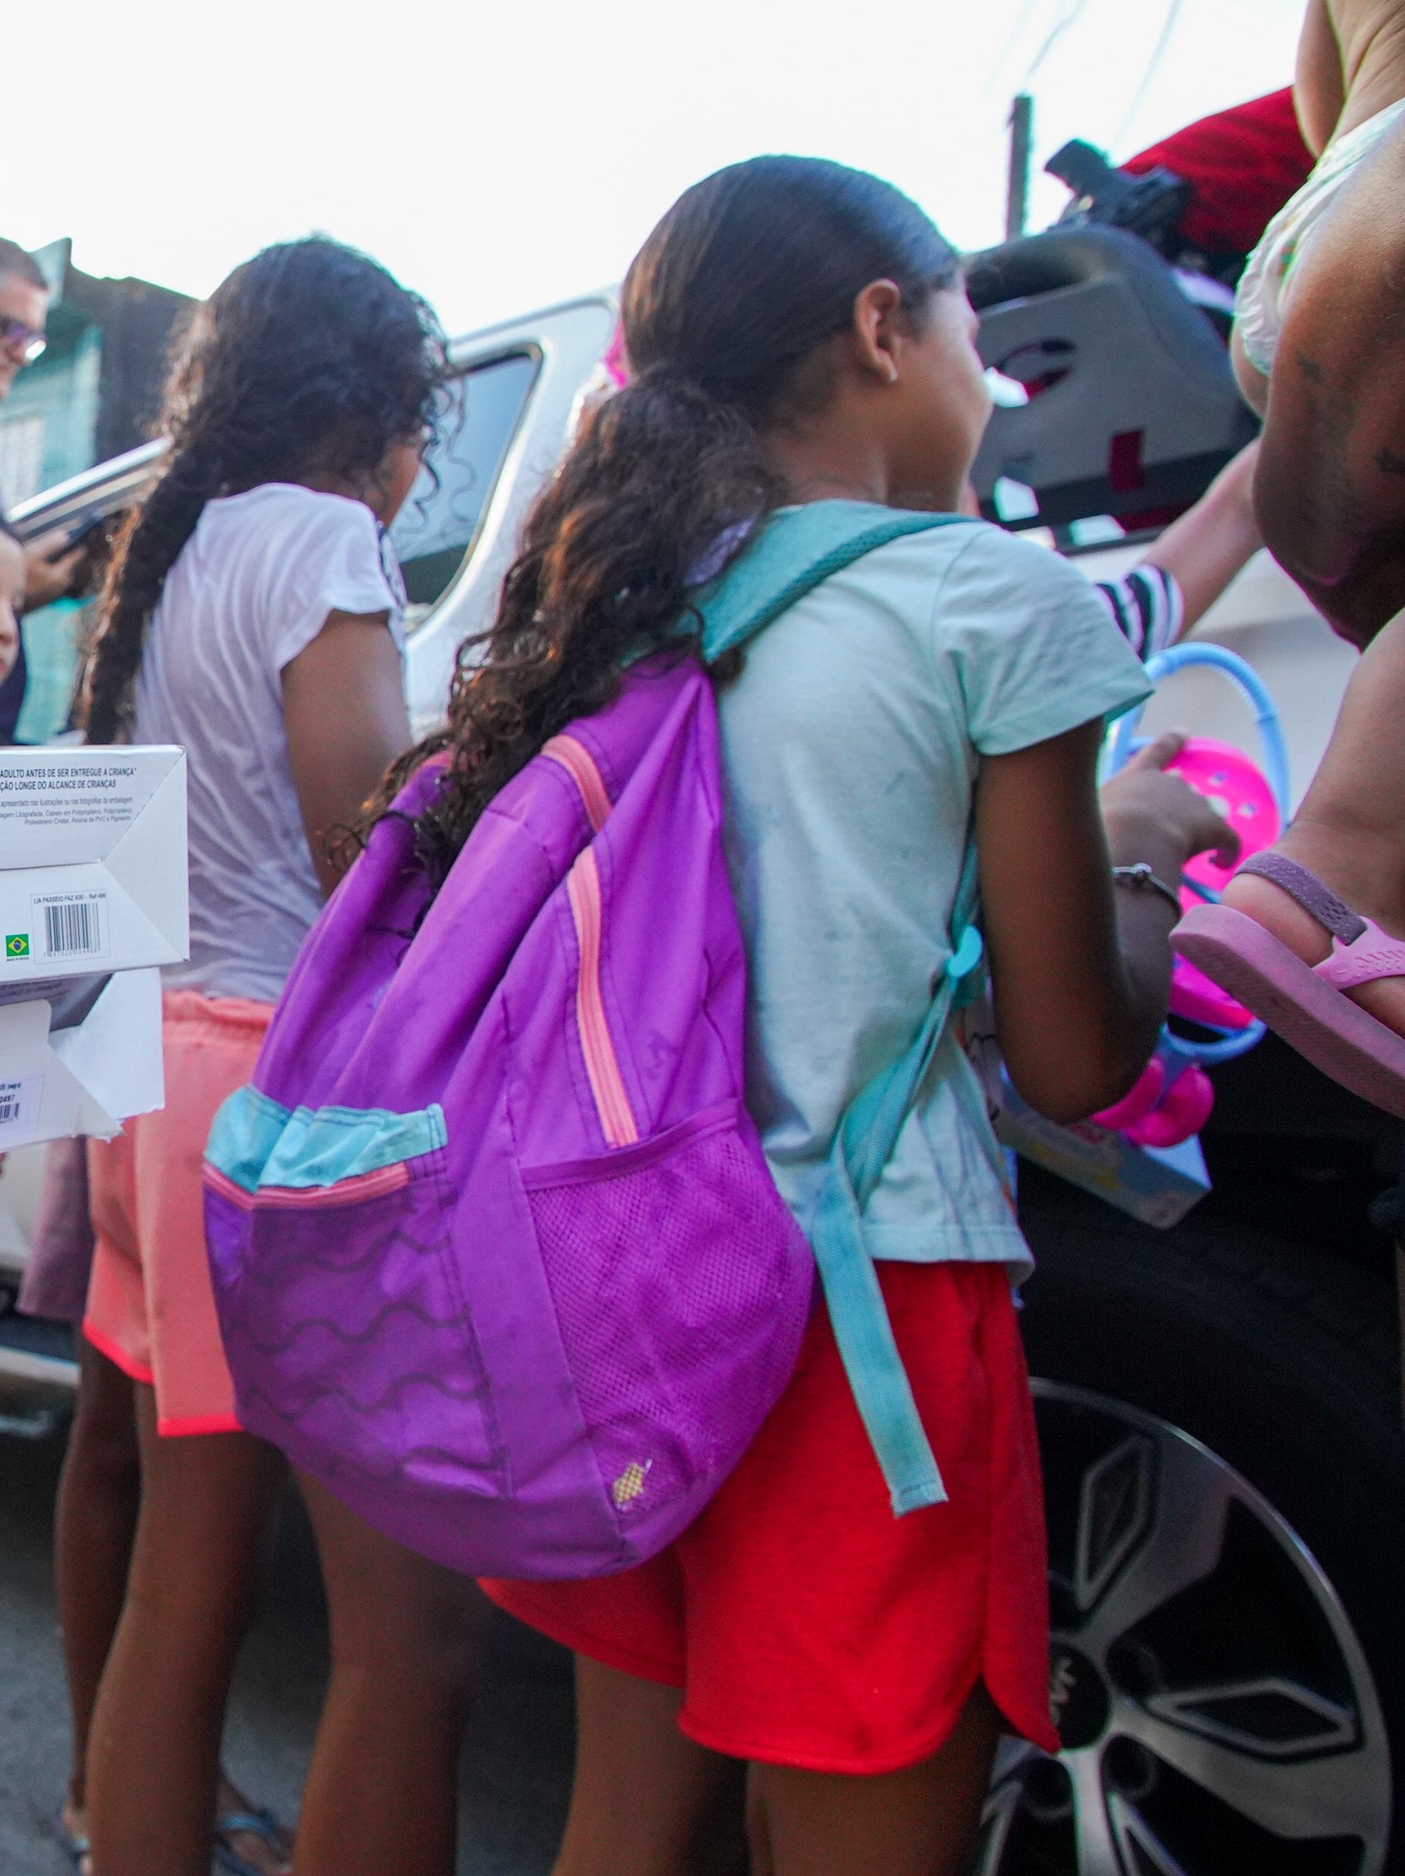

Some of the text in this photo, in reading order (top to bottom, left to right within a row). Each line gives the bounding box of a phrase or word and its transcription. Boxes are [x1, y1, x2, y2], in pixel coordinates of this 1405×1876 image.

[0, 769, 24, 778] ADULTO
[26, 768, 46, 778] ANTES
[48, 768, 56, 778] DE
[57, 768, 69, 777] SER
[70, 768, 102, 777] ENTREGUE
[103, 767, 108, 776] A
[15, 781, 36, 790] LONGE
[38, 781, 46, 790] DO
[48, 780, 76, 790] ALCANCE
[78, 780, 85, 789] DE
[87, 779, 117, 790] CRIANÇAS
